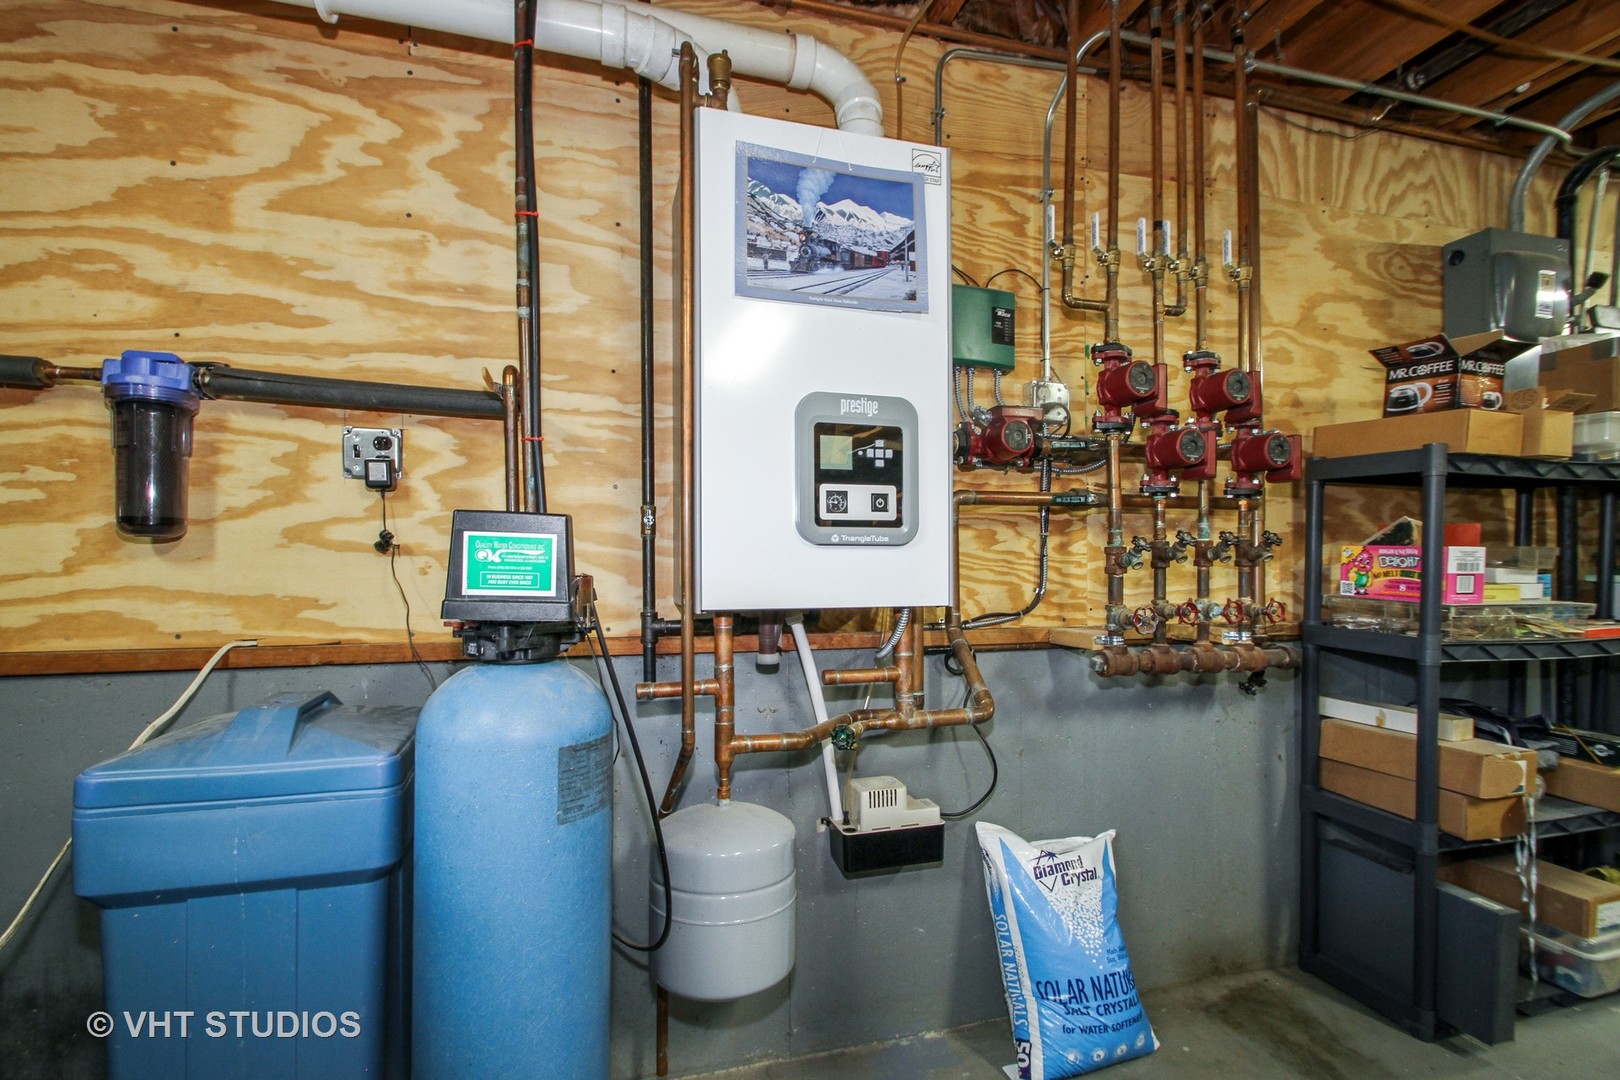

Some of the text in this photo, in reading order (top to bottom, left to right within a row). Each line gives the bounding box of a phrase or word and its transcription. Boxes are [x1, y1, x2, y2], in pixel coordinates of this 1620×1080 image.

[840, 398, 879, 417] prestige
[841, 534, 889, 543] TriangleTube
[1033, 855, 1084, 880] Diamond
[995, 914, 1014, 958] SOLAR
[1036, 978, 1089, 1006] SOLAR
[1063, 994, 1140, 1017] SALT CRYSTAL
[1062, 1024, 1076, 1034] for
[1079, 1024, 1109, 1035] WATER
